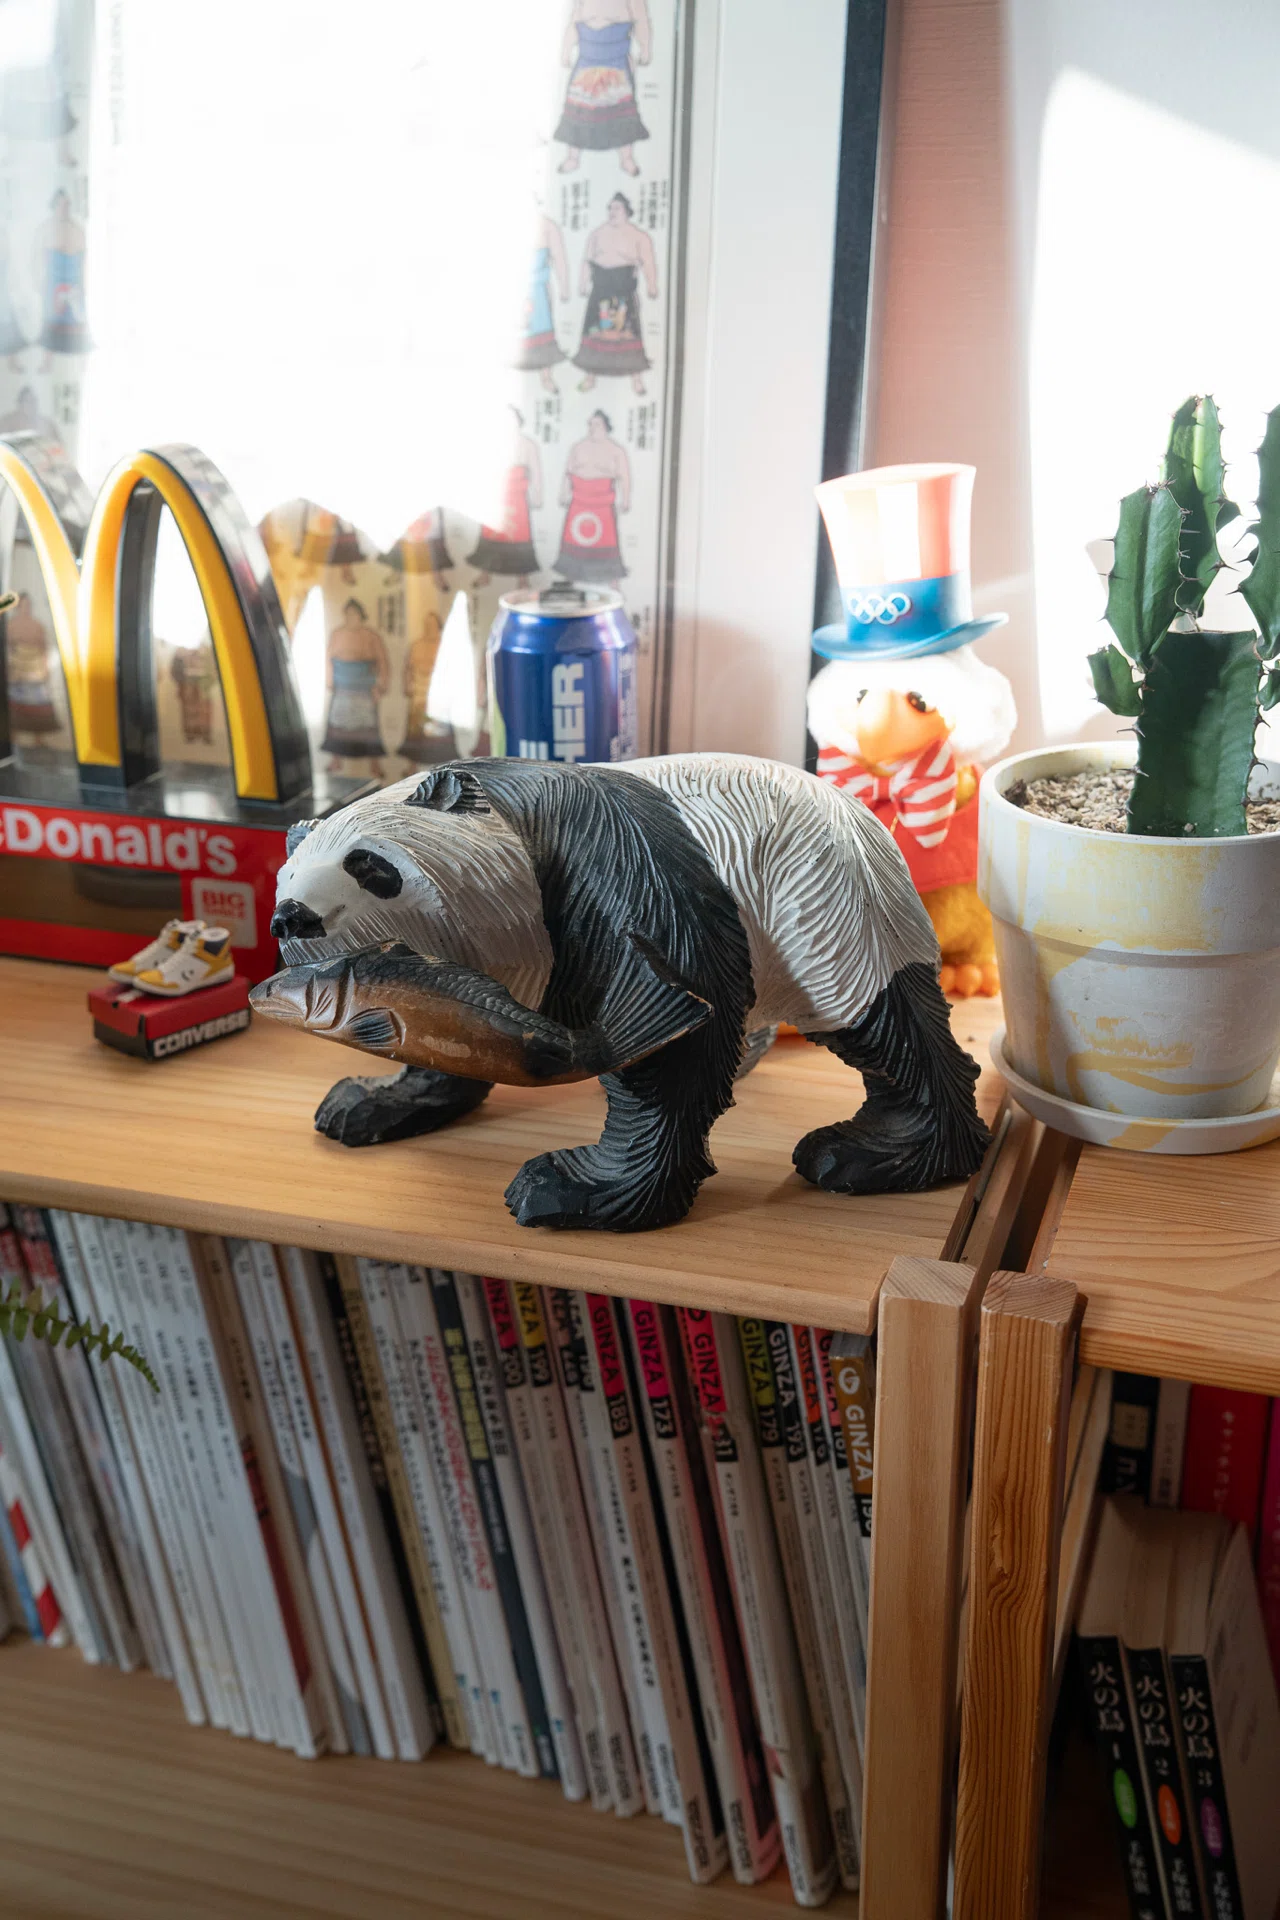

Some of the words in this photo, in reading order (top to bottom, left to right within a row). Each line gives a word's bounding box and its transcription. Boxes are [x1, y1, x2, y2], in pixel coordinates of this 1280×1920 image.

[0, 808, 237, 875] Donald's
[153, 1008, 250, 1057] CONVERSE
[486, 1280, 513, 1335] INZA
[515, 1281, 541, 1335] NZA
[593, 1307, 619, 1384] GINZA
[634, 1310, 664, 1384] GINZA
[651, 1400, 675, 1435] 173
[694, 1333, 722, 1407] GINZA
[743, 1318, 769, 1393] GINZA
[759, 1406, 779, 1442] 179
[769, 1328, 796, 1407] GINZA
[785, 1422, 805, 1456] 193
[845, 1404, 873, 1482] GINZA
[1089, 1660, 1126, 1733] 火の鳥
[1135, 1675, 1172, 1748] 火の鳥
[1178, 1686, 1215, 1760] 火の鳥
